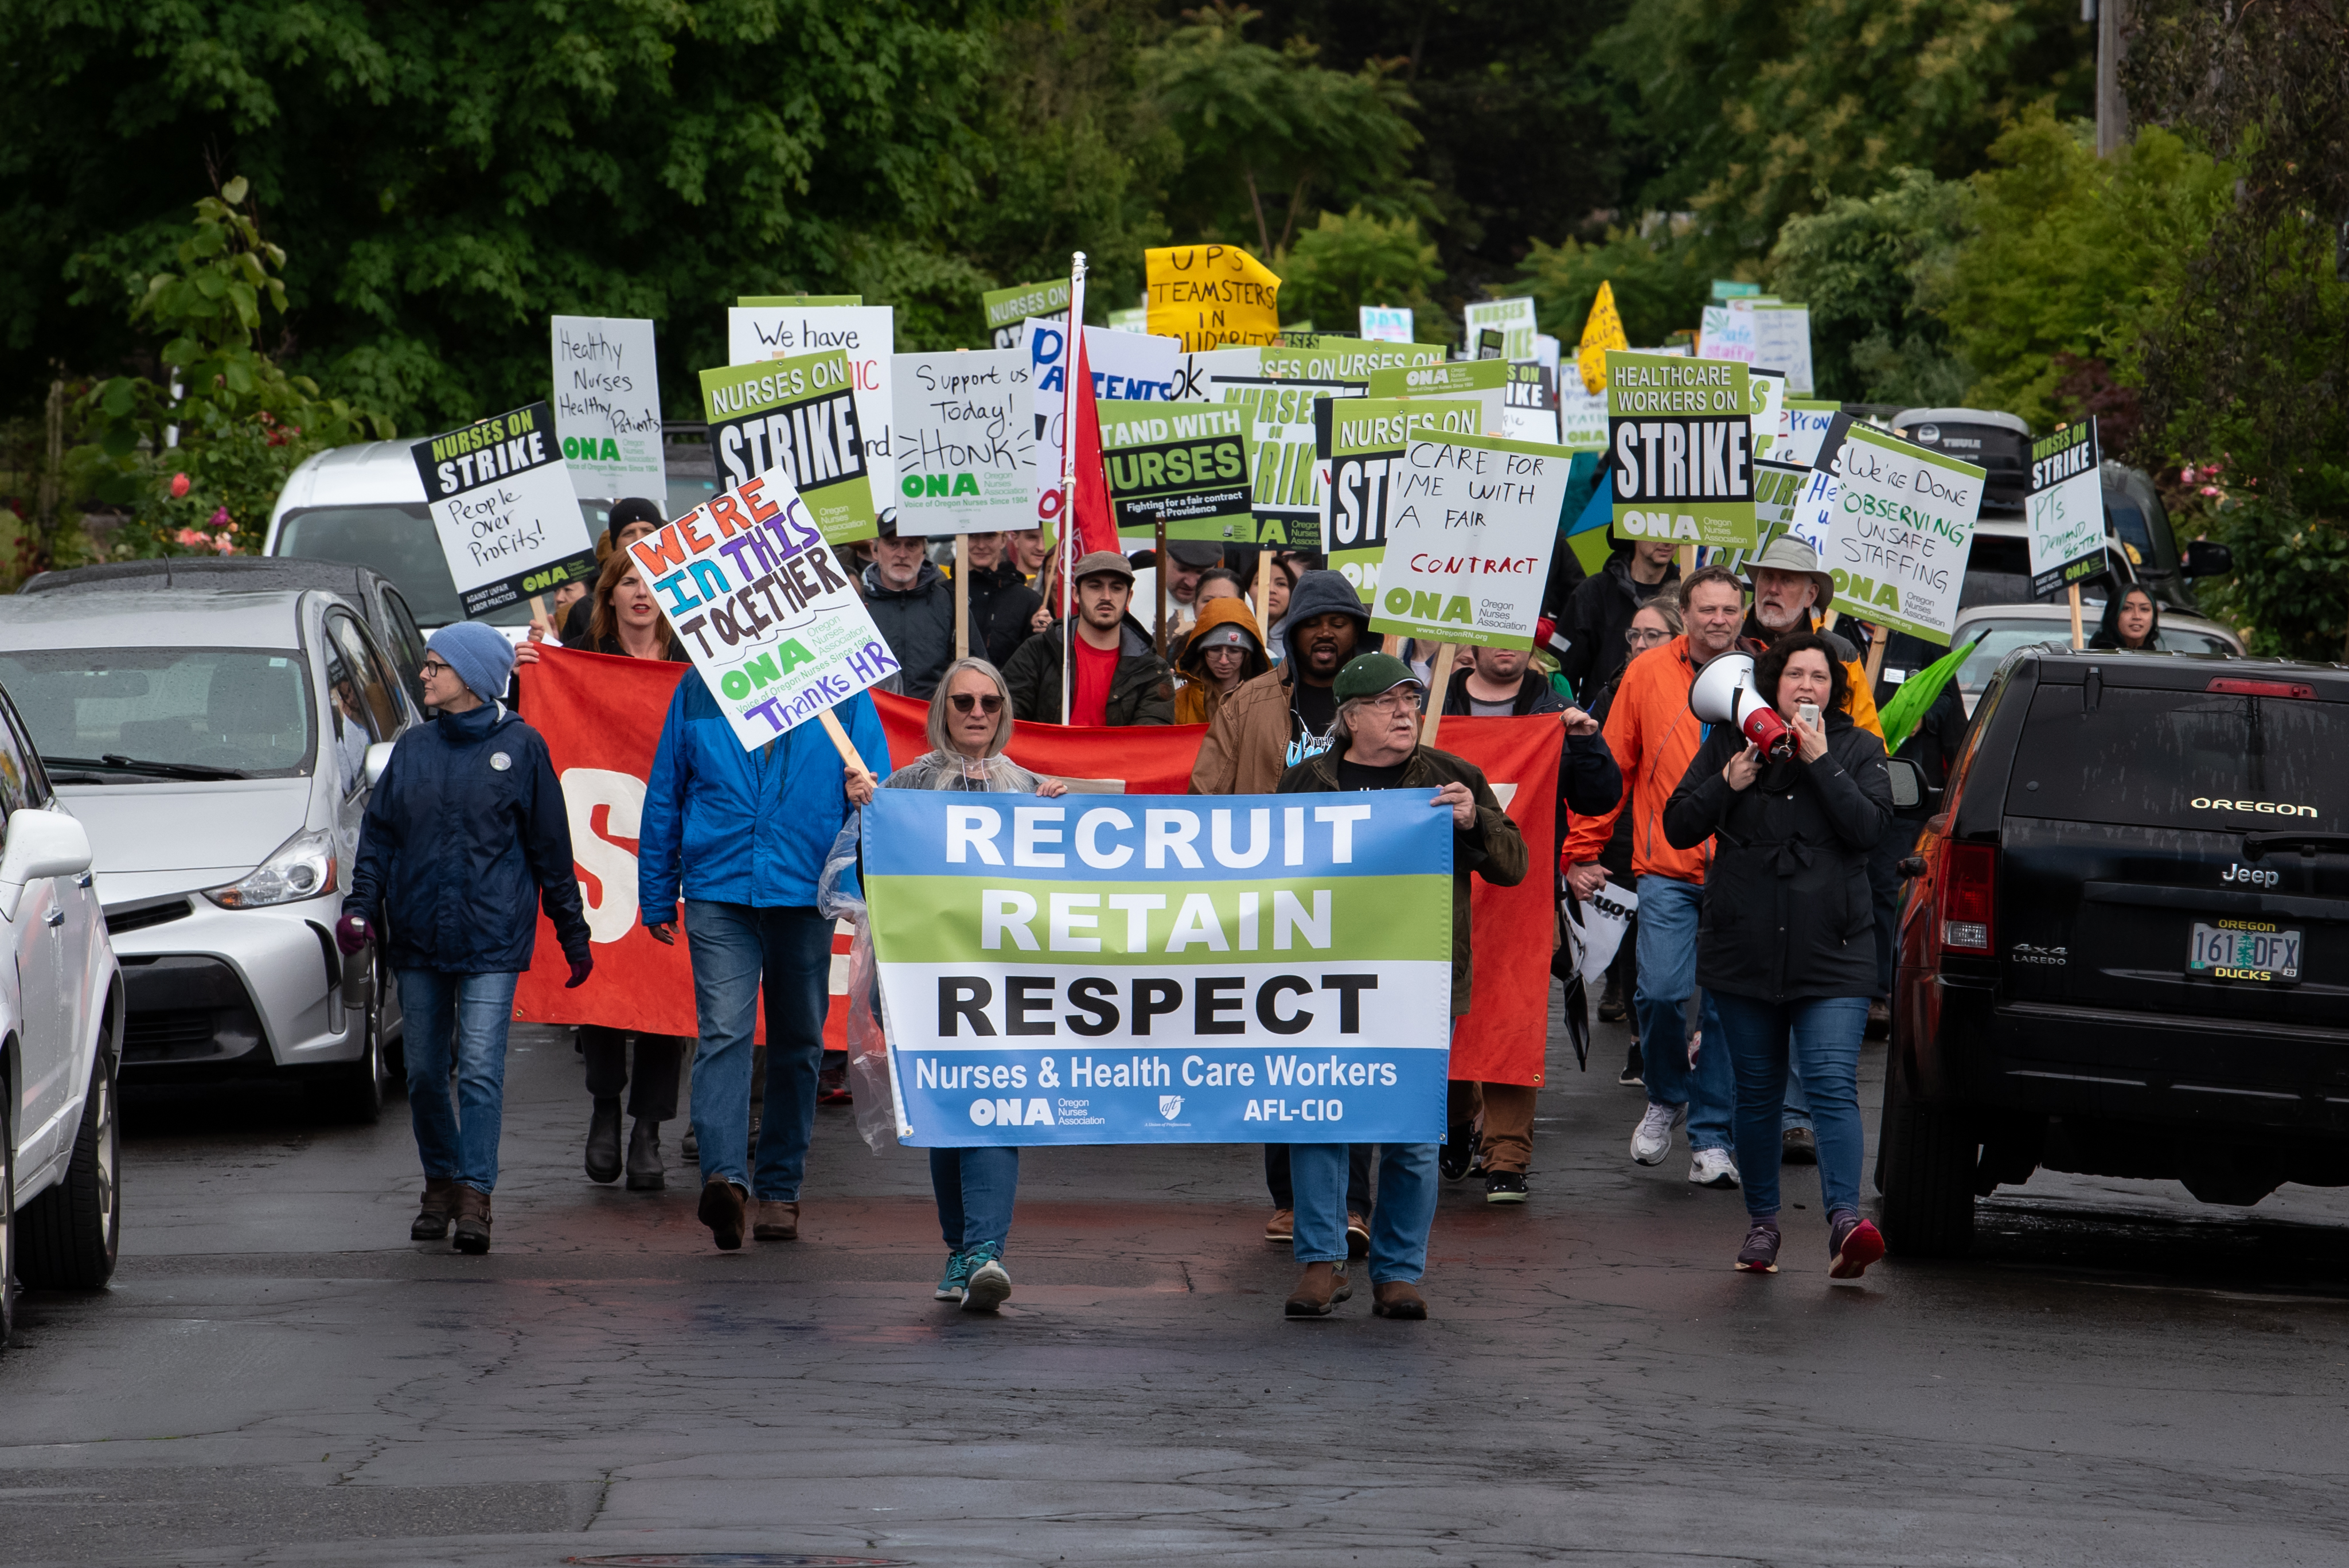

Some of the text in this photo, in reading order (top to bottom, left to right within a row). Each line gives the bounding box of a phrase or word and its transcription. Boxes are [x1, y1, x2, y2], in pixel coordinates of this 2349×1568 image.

[1172, 245, 1244, 272] UPS
[989, 284, 1068, 323] NURSES ON
[1152, 279, 1275, 310] TEAMSTERS
[1199, 310, 1224, 329] IN
[754, 319, 860, 349] We have
[560, 327, 622, 369] Healthy
[1308, 358, 1336, 380] ON
[1339, 352, 1405, 376] URSES
[1520, 365, 1539, 383] ON
[1614, 366, 1731, 387] HEALTHCARE
[574, 368, 633, 391] Nurses
[711, 357, 845, 416] NURSES ON
[916, 365, 1029, 394] Support us
[1406, 369, 1449, 386] ONA
[559, 392, 611, 421] Healthy
[1617, 390, 1738, 412] WORKERS ON
[611, 408, 661, 436] Patients
[930, 393, 1015, 439] Today!
[1099, 409, 1241, 448] TAND WITH
[1339, 408, 1476, 449] NURSES ON
[431, 409, 534, 462] NURSES ON
[719, 396, 860, 494] STRIKE
[1269, 426, 1283, 439] ON
[2032, 422, 2087, 463] NURSES ON
[563, 436, 621, 461] ONA
[920, 428, 1017, 471] HONK
[1410, 442, 1544, 477] CARE FOR
[1616, 421, 1748, 499] STRIKE
[437, 431, 546, 494] STRIKE
[2032, 441, 2090, 490] STRIKE
[901, 473, 981, 498] ONA
[984, 471, 1013, 481] Oregon
[984, 487, 1028, 496] Association
[1403, 474, 1535, 505] ME WITH
[448, 488, 522, 525] People
[819, 505, 849, 516] Oregon
[904, 500, 923, 508] Voice
[925, 500, 933, 508] of
[934, 500, 961, 509] Oregon
[962, 498, 988, 506] Nurses
[1012, 496, 1028, 504] 1904
[1126, 490, 1243, 516] Fighting for a fair contract
[1166, 504, 1217, 517] Providence
[631, 477, 780, 577] WE'RE
[821, 514, 849, 524] Nurses
[822, 520, 867, 533] Association
[1395, 505, 1487, 529] A FAIR
[1623, 510, 1702, 541] ONA
[1703, 517, 1733, 527] Oregon
[719, 497, 821, 583] THIS
[1291, 528, 1318, 537] Nurses
[1703, 525, 1731, 535] Nurses
[1704, 533, 1747, 544] Association
[1857, 516, 1936, 558] UNSAFE
[467, 519, 546, 567] Profits!
[1410, 553, 1539, 575] CONTRACT
[1841, 537, 1949, 594] STAFFING
[2065, 560, 2091, 580] ONA
[522, 566, 569, 592] ONA
[1828, 568, 1900, 613] ONA
[466, 583, 509, 604] AGAINST UNFAIR
[469, 591, 517, 614] LABOR PRACTICES
[680, 547, 848, 660] TOGETHER
[1384, 587, 1473, 625] ONA
[1480, 598, 1514, 611] Oregon
[1906, 591, 1935, 606] Oregon
[1479, 609, 1510, 620] Nurses
[1852, 605, 1913, 630] www.OregonRN.org
[1902, 608, 1946, 627] Association
[1905, 600, 1932, 614] Nurses
[807, 614, 841, 637] Oregon
[812, 626, 844, 647] Nurses
[1416, 626, 1488, 642] www.OregonRN.org
[1476, 618, 1527, 631] Association
[818, 625, 868, 657] Association
[721, 637, 817, 701] ONA
[736, 634, 874, 715] Voice of Oregon Nurses Since 1904
[846, 641, 899, 684] HR
[2191, 798, 2318, 818] OREGON
[946, 804, 1372, 869] RECRUIT
[2222, 864, 2279, 888] Jeep
[981, 888, 1332, 954] RETAIN
[2218, 919, 2276, 932] OREGON
[2013, 943, 2067, 955] 4x4
[2013, 954, 2066, 965] LAREDO
[2197, 931, 2297, 968] 161 DFX
[2215, 967, 2271, 981] DUCKS
[938, 974, 1378, 1037] RESPECT
[916, 1054, 1397, 1090] Nurses & Health Care Workers
[969, 1098, 1055, 1126] ONA
[1058, 1098, 1090, 1107] Oregon
[1058, 1107, 1087, 1116] Nurses
[1243, 1099, 1344, 1122] AFL-CIO
[1058, 1116, 1105, 1125] Association
